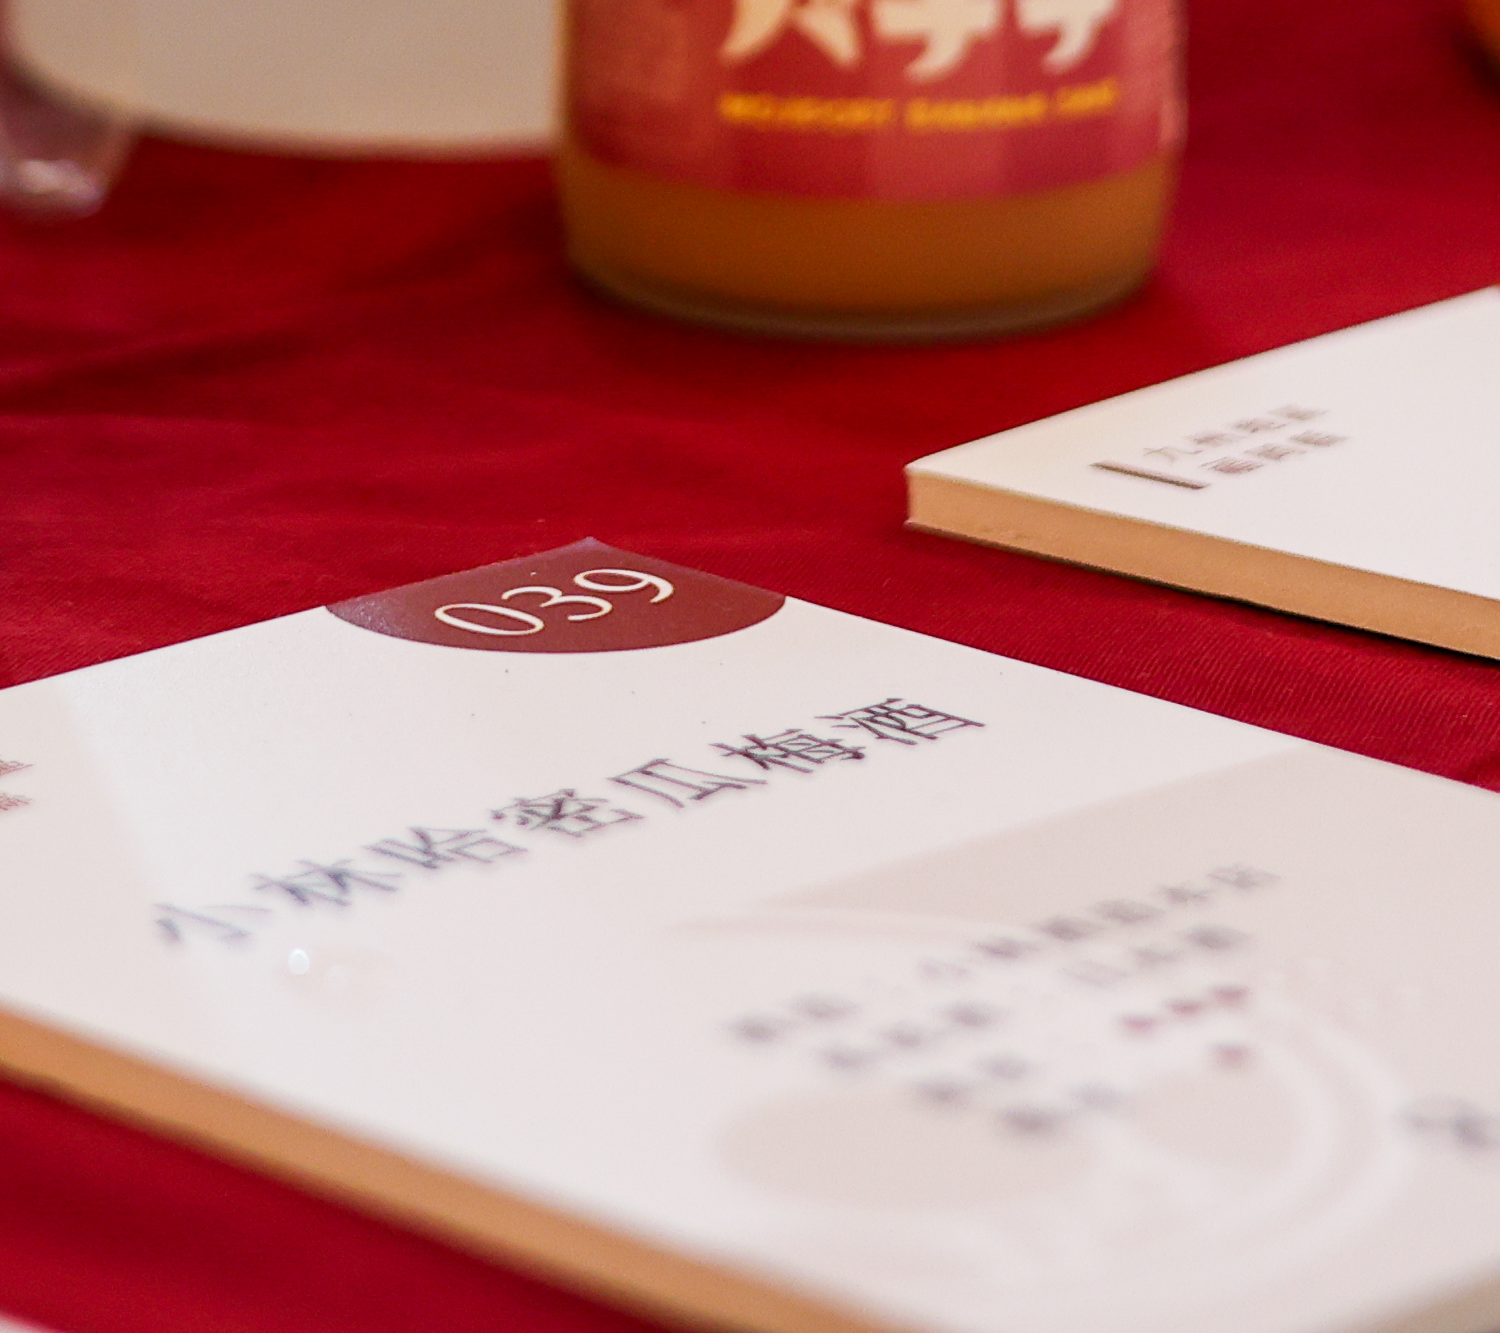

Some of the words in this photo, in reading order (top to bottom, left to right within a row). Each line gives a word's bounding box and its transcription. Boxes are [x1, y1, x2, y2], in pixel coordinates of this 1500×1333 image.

[432, 565, 676, 638] 039
[152, 697, 987, 945] 小林哈密瓜梅酒
